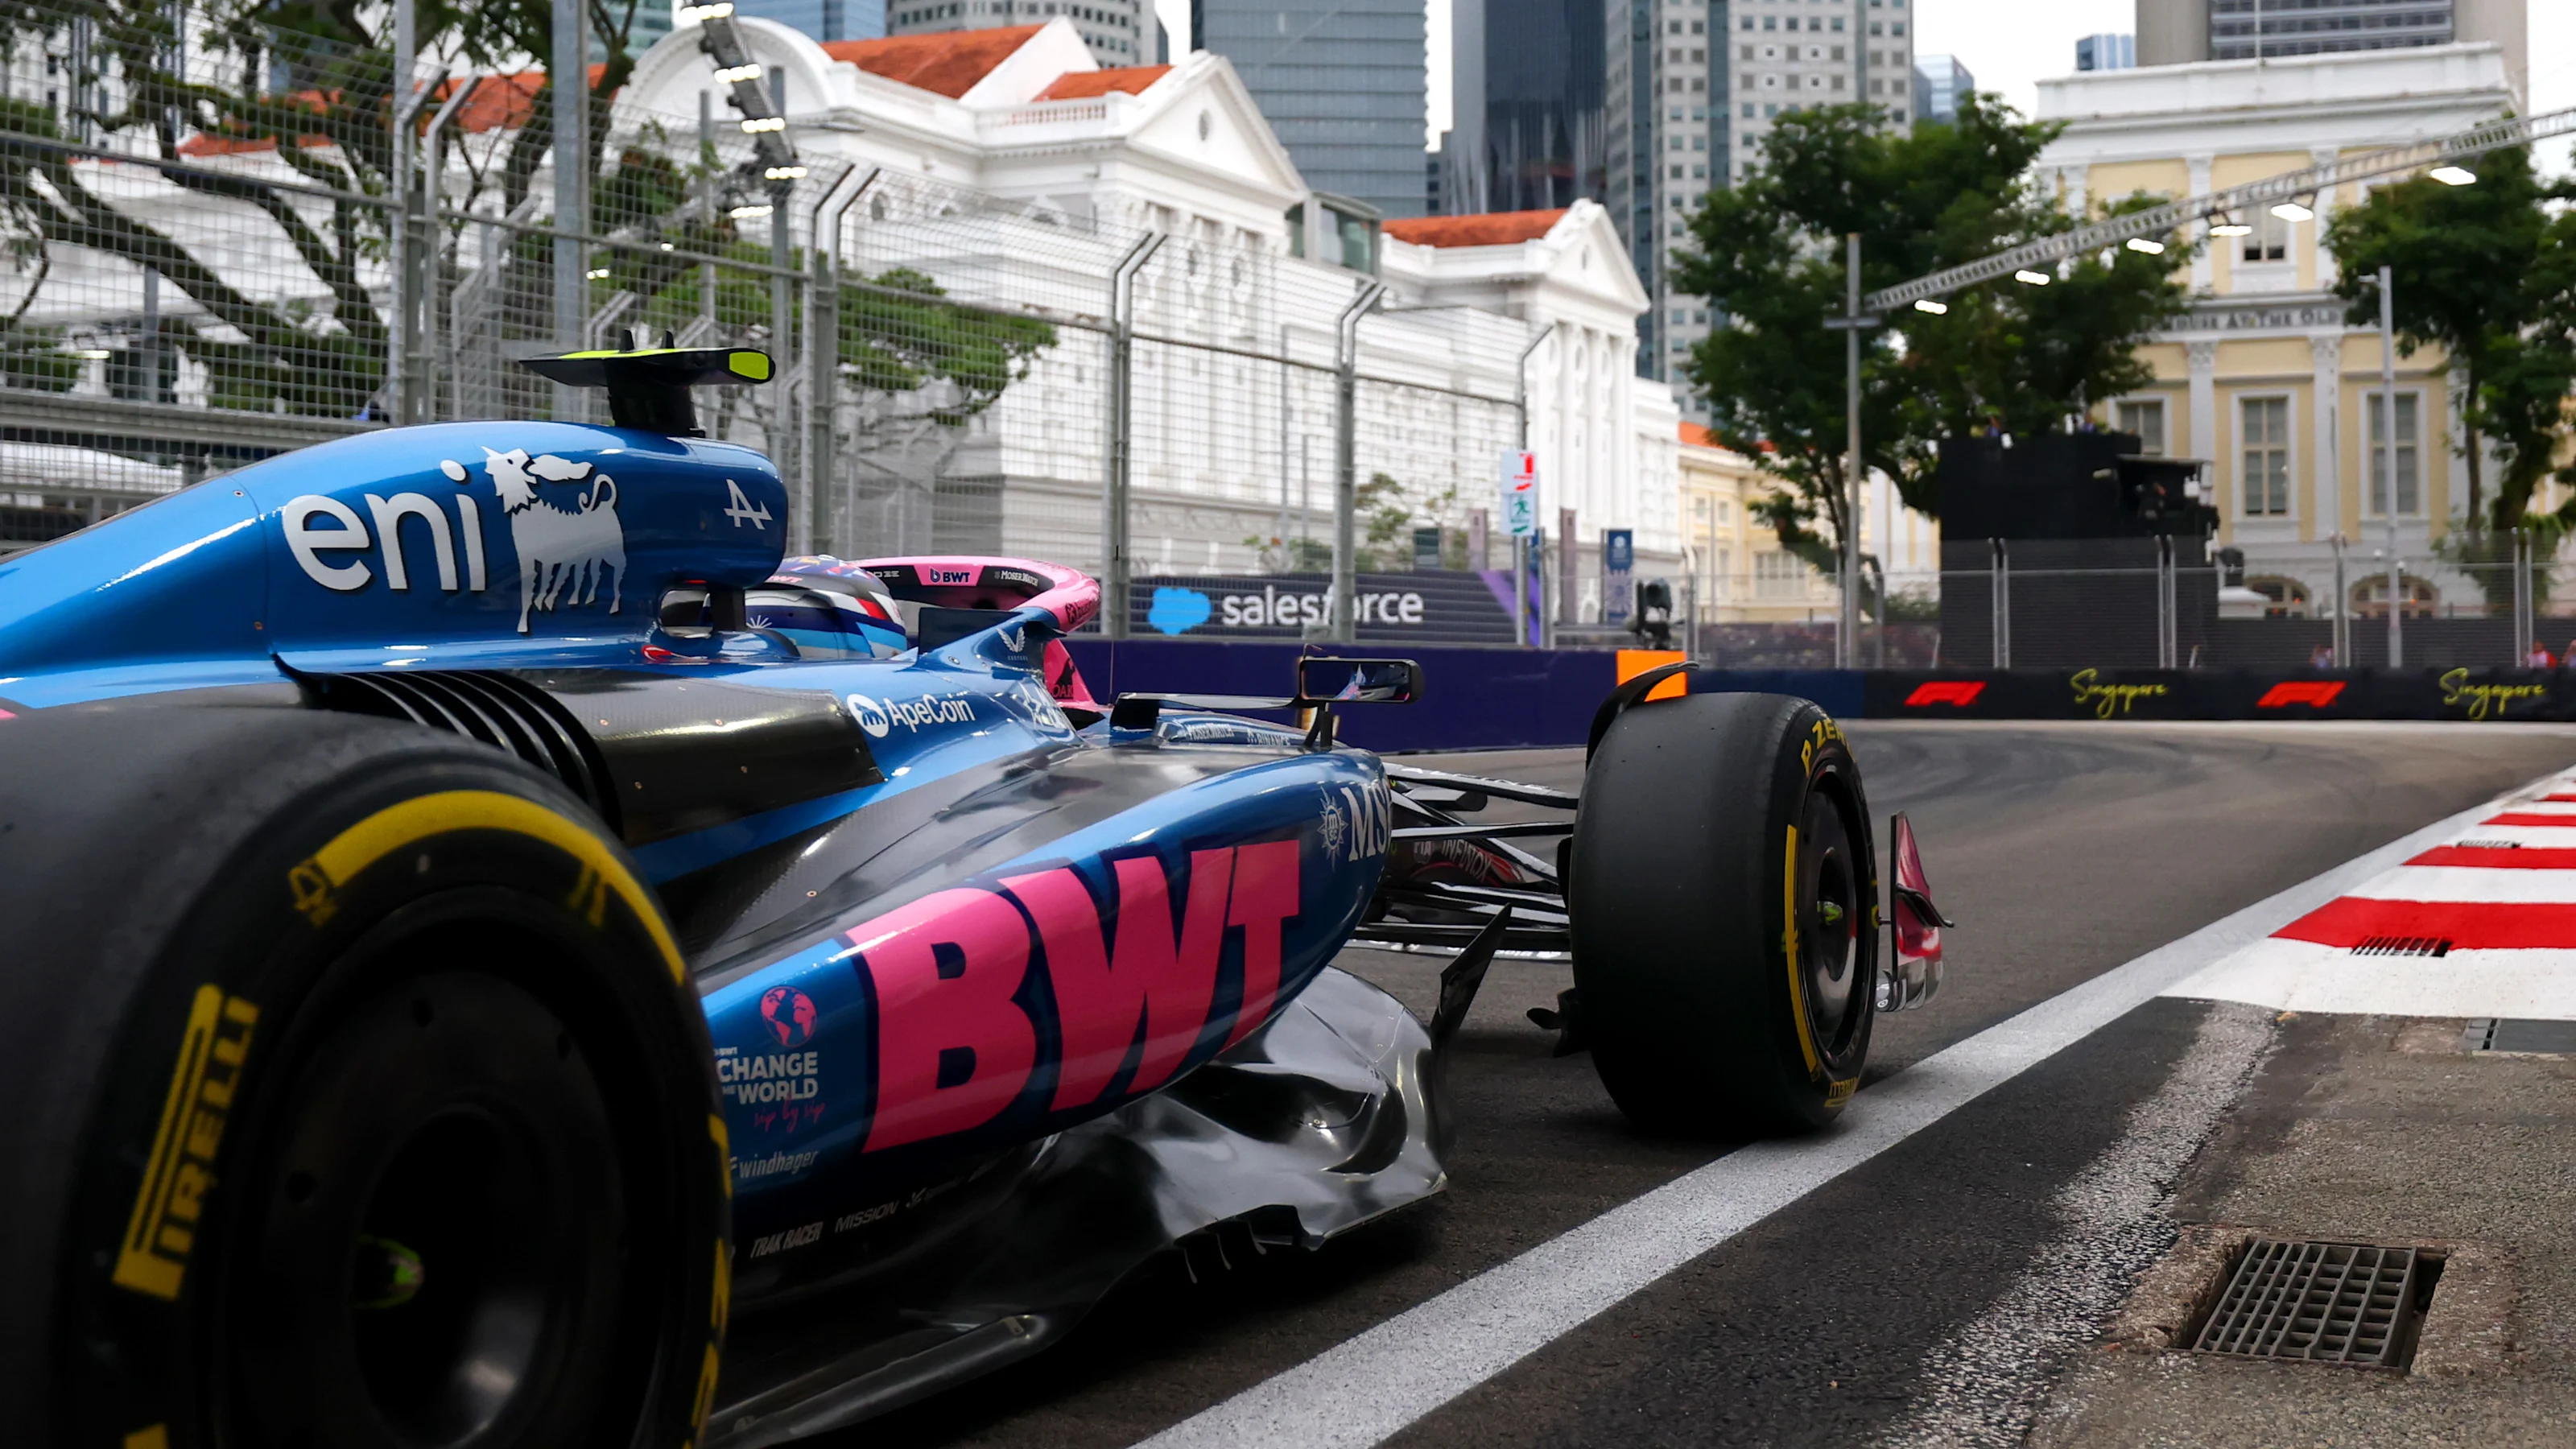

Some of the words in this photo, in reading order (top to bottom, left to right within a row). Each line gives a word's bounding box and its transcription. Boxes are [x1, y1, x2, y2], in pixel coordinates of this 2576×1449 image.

[282, 460, 486, 591] eni
[943, 572, 970, 583] BWT
[1222, 584, 1424, 625] salesfrce
[2070, 668, 2167, 719] Singapore
[2439, 667, 2545, 720] Singapore
[883, 694, 976, 733] ApeCoin
[845, 840, 1300, 1154] BWT
[716, 1051, 819, 1083] CHANGE
[737, 1078, 819, 1104] WORLD
[113, 984, 260, 1302] PIRELLI
[739, 1150, 819, 1178] windhager
[834, 1200, 902, 1233] MISSION
[749, 1232, 783, 1258] TRAK
[782, 1222, 824, 1249] RACER
